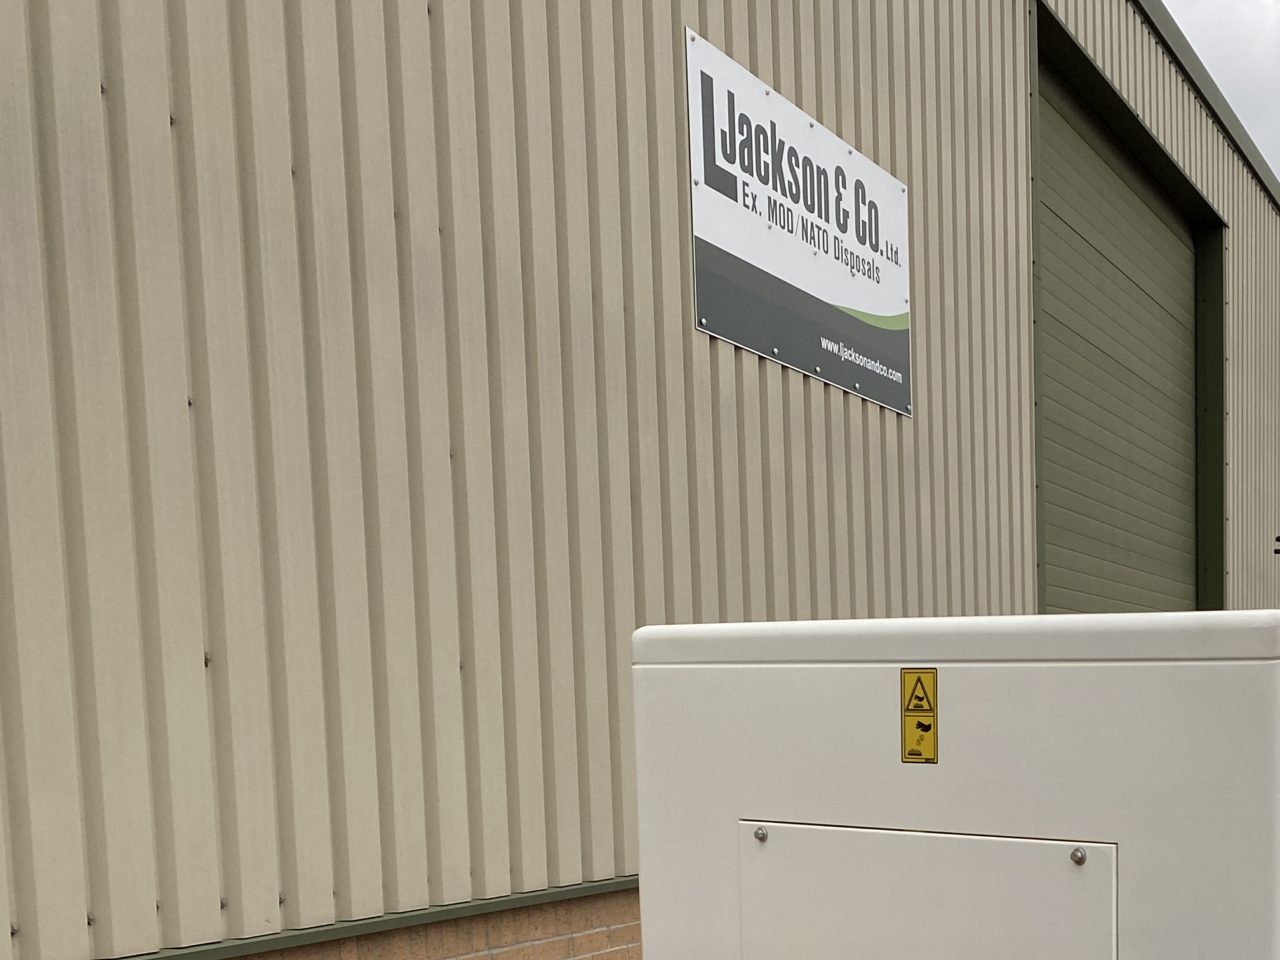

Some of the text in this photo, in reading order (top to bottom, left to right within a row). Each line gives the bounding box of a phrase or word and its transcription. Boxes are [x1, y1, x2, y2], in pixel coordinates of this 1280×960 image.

[742, 180, 881, 284] Ex. MOD/NATO Disposals
[834, 165, 849, 234] &
[854, 178, 884, 257] Co.
[885, 240, 902, 268] Ltd.
[820, 336, 903, 384] www.ljacksonandco.com
